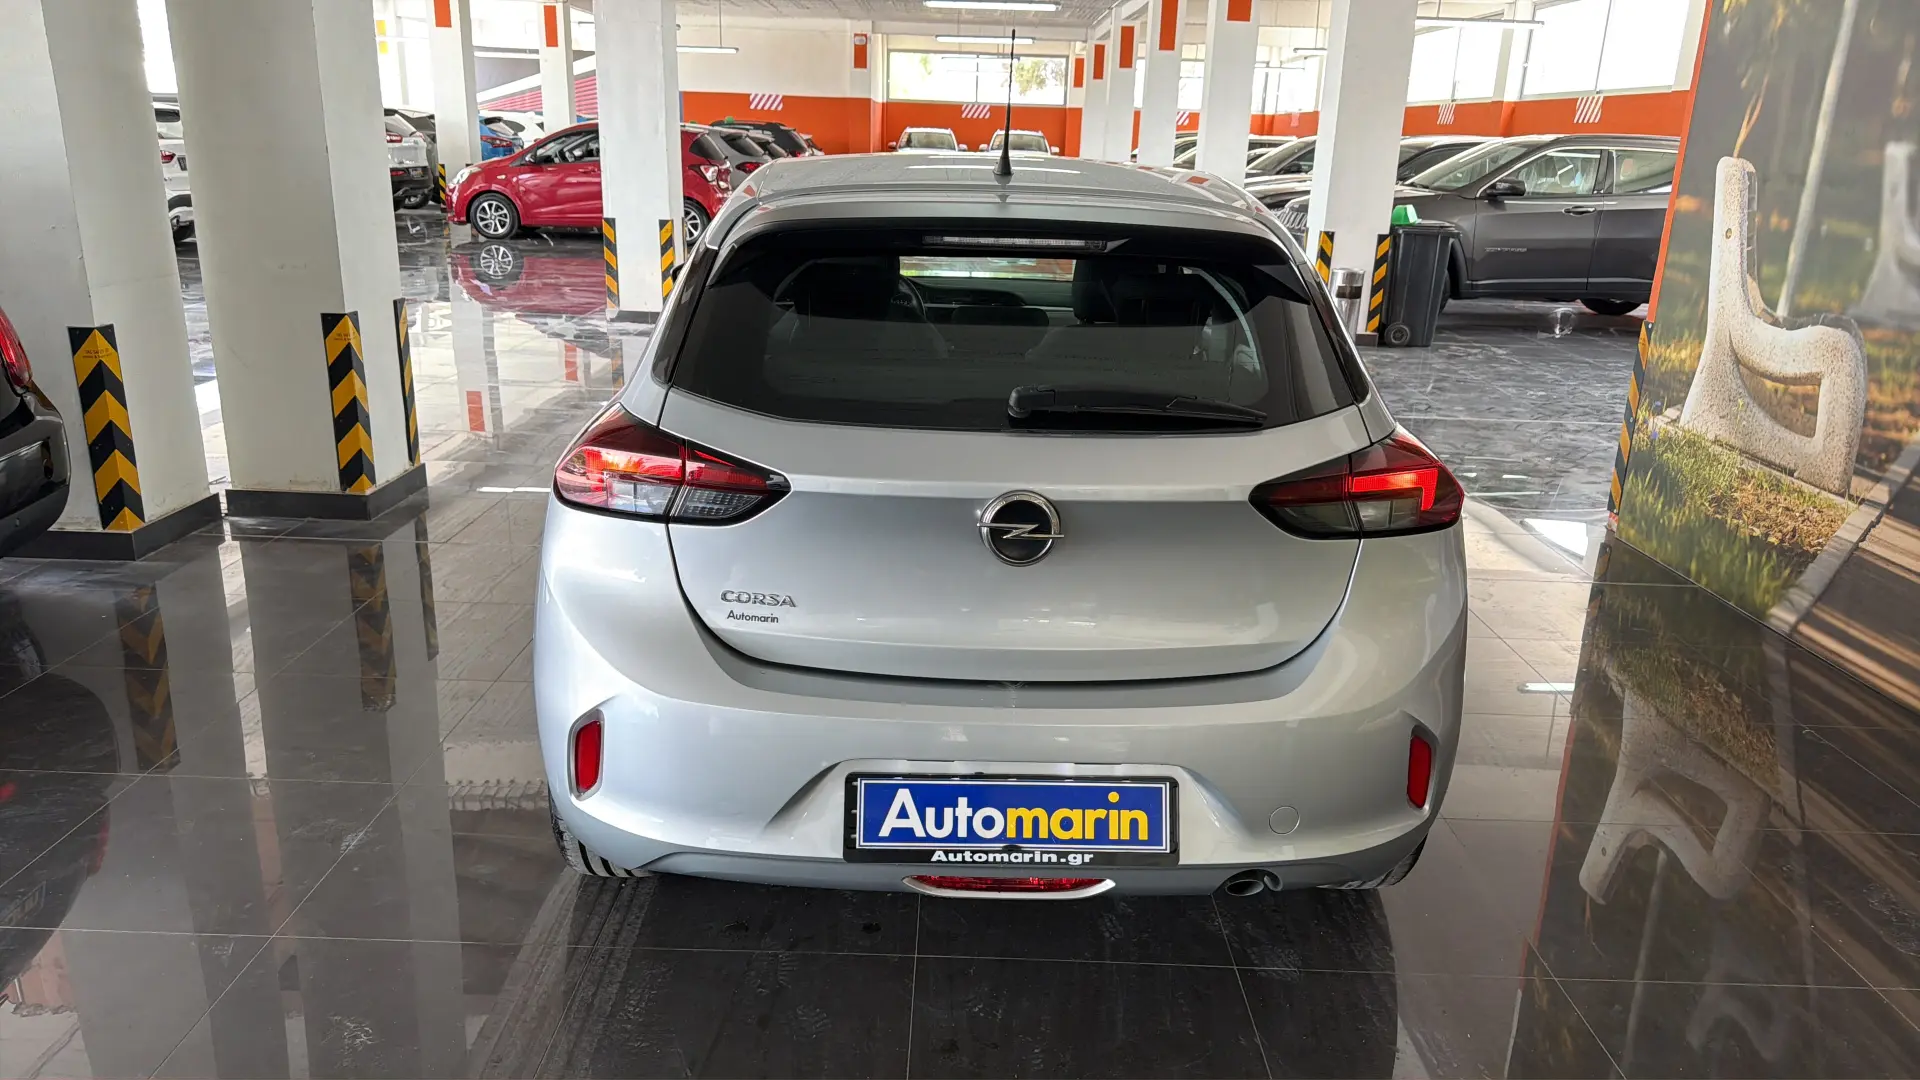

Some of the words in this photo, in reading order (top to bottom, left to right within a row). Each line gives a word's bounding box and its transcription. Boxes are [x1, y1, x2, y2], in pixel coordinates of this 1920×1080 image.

[720, 590, 797, 608] CORSA
[726, 609, 779, 624] Automarin
[878, 788, 1149, 841] Automarin
[930, 850, 1094, 866] Automarin.gr
